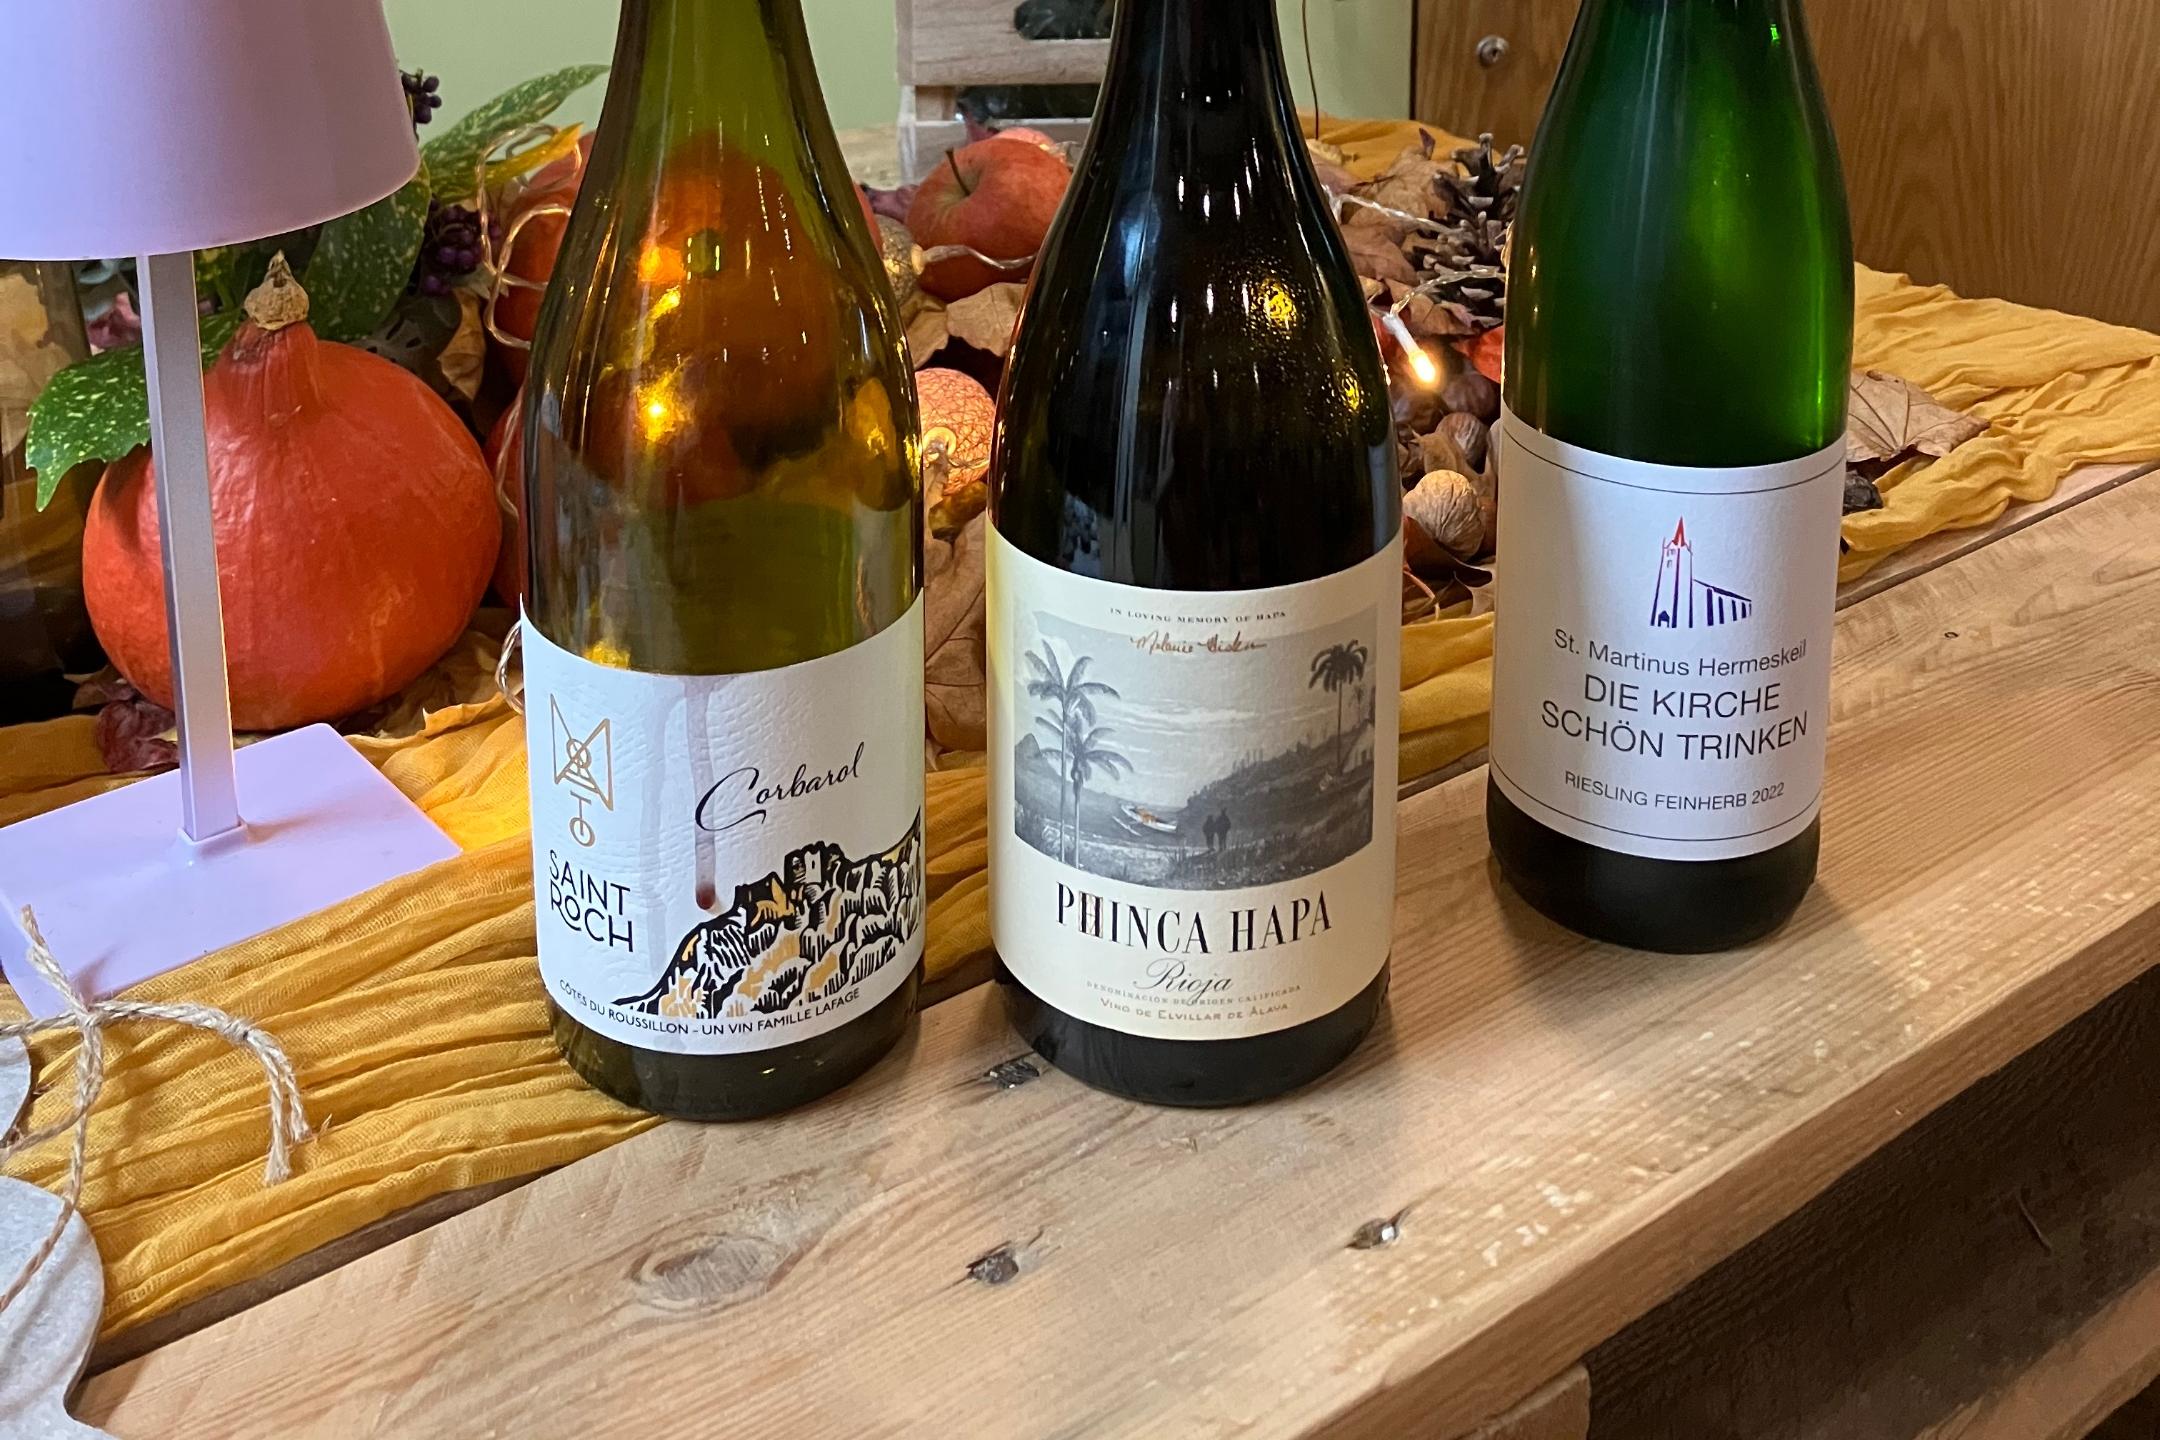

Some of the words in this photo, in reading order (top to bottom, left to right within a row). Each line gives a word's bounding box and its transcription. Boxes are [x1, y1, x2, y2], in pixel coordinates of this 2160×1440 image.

[1109, 607, 1122, 616] IN
[1127, 609, 1172, 623] LOVING
[1177, 615, 1229, 624] MEMORY
[1235, 614, 1251, 623] OF
[1256, 610, 1287, 621] HAPA
[1553, 628, 1580, 655] St.
[1588, 640, 1690, 677] Martinus
[1698, 638, 1807, 677] Hermeskeil
[1584, 673, 1640, 712] DIE
[1652, 682, 1781, 719] KIRCHE
[1541, 700, 1664, 758] SCHÖN
[1676, 710, 1808, 761] TRINKEN
[694, 741, 865, 832] Corbarol
[1564, 771, 1648, 806] RIESLING
[1654, 792, 1747, 811] FEINHERB
[1751, 781, 1785, 805] 2022
[548, 848, 631, 916] SAINT
[550, 880, 634, 953] ROCH
[1055, 881, 1212, 955] PHINCA
[1228, 890, 1332, 954] HAPA
[559, 978, 588, 1008] CÔTES
[589, 999, 606, 1016] DU
[608, 1009, 689, 1035] ROUSSILLON
[702, 1025, 724, 1035] UN
[731, 1022, 753, 1035] VIN
[757, 1008, 812, 1032] FAMILLE
[815, 987, 860, 1018] LAFAGE
[1132, 957, 1234, 1006] Rioja
[1187, 996, 1233, 1005] ORIGEN
[1237, 984, 1302, 1003] CALIFICADA
